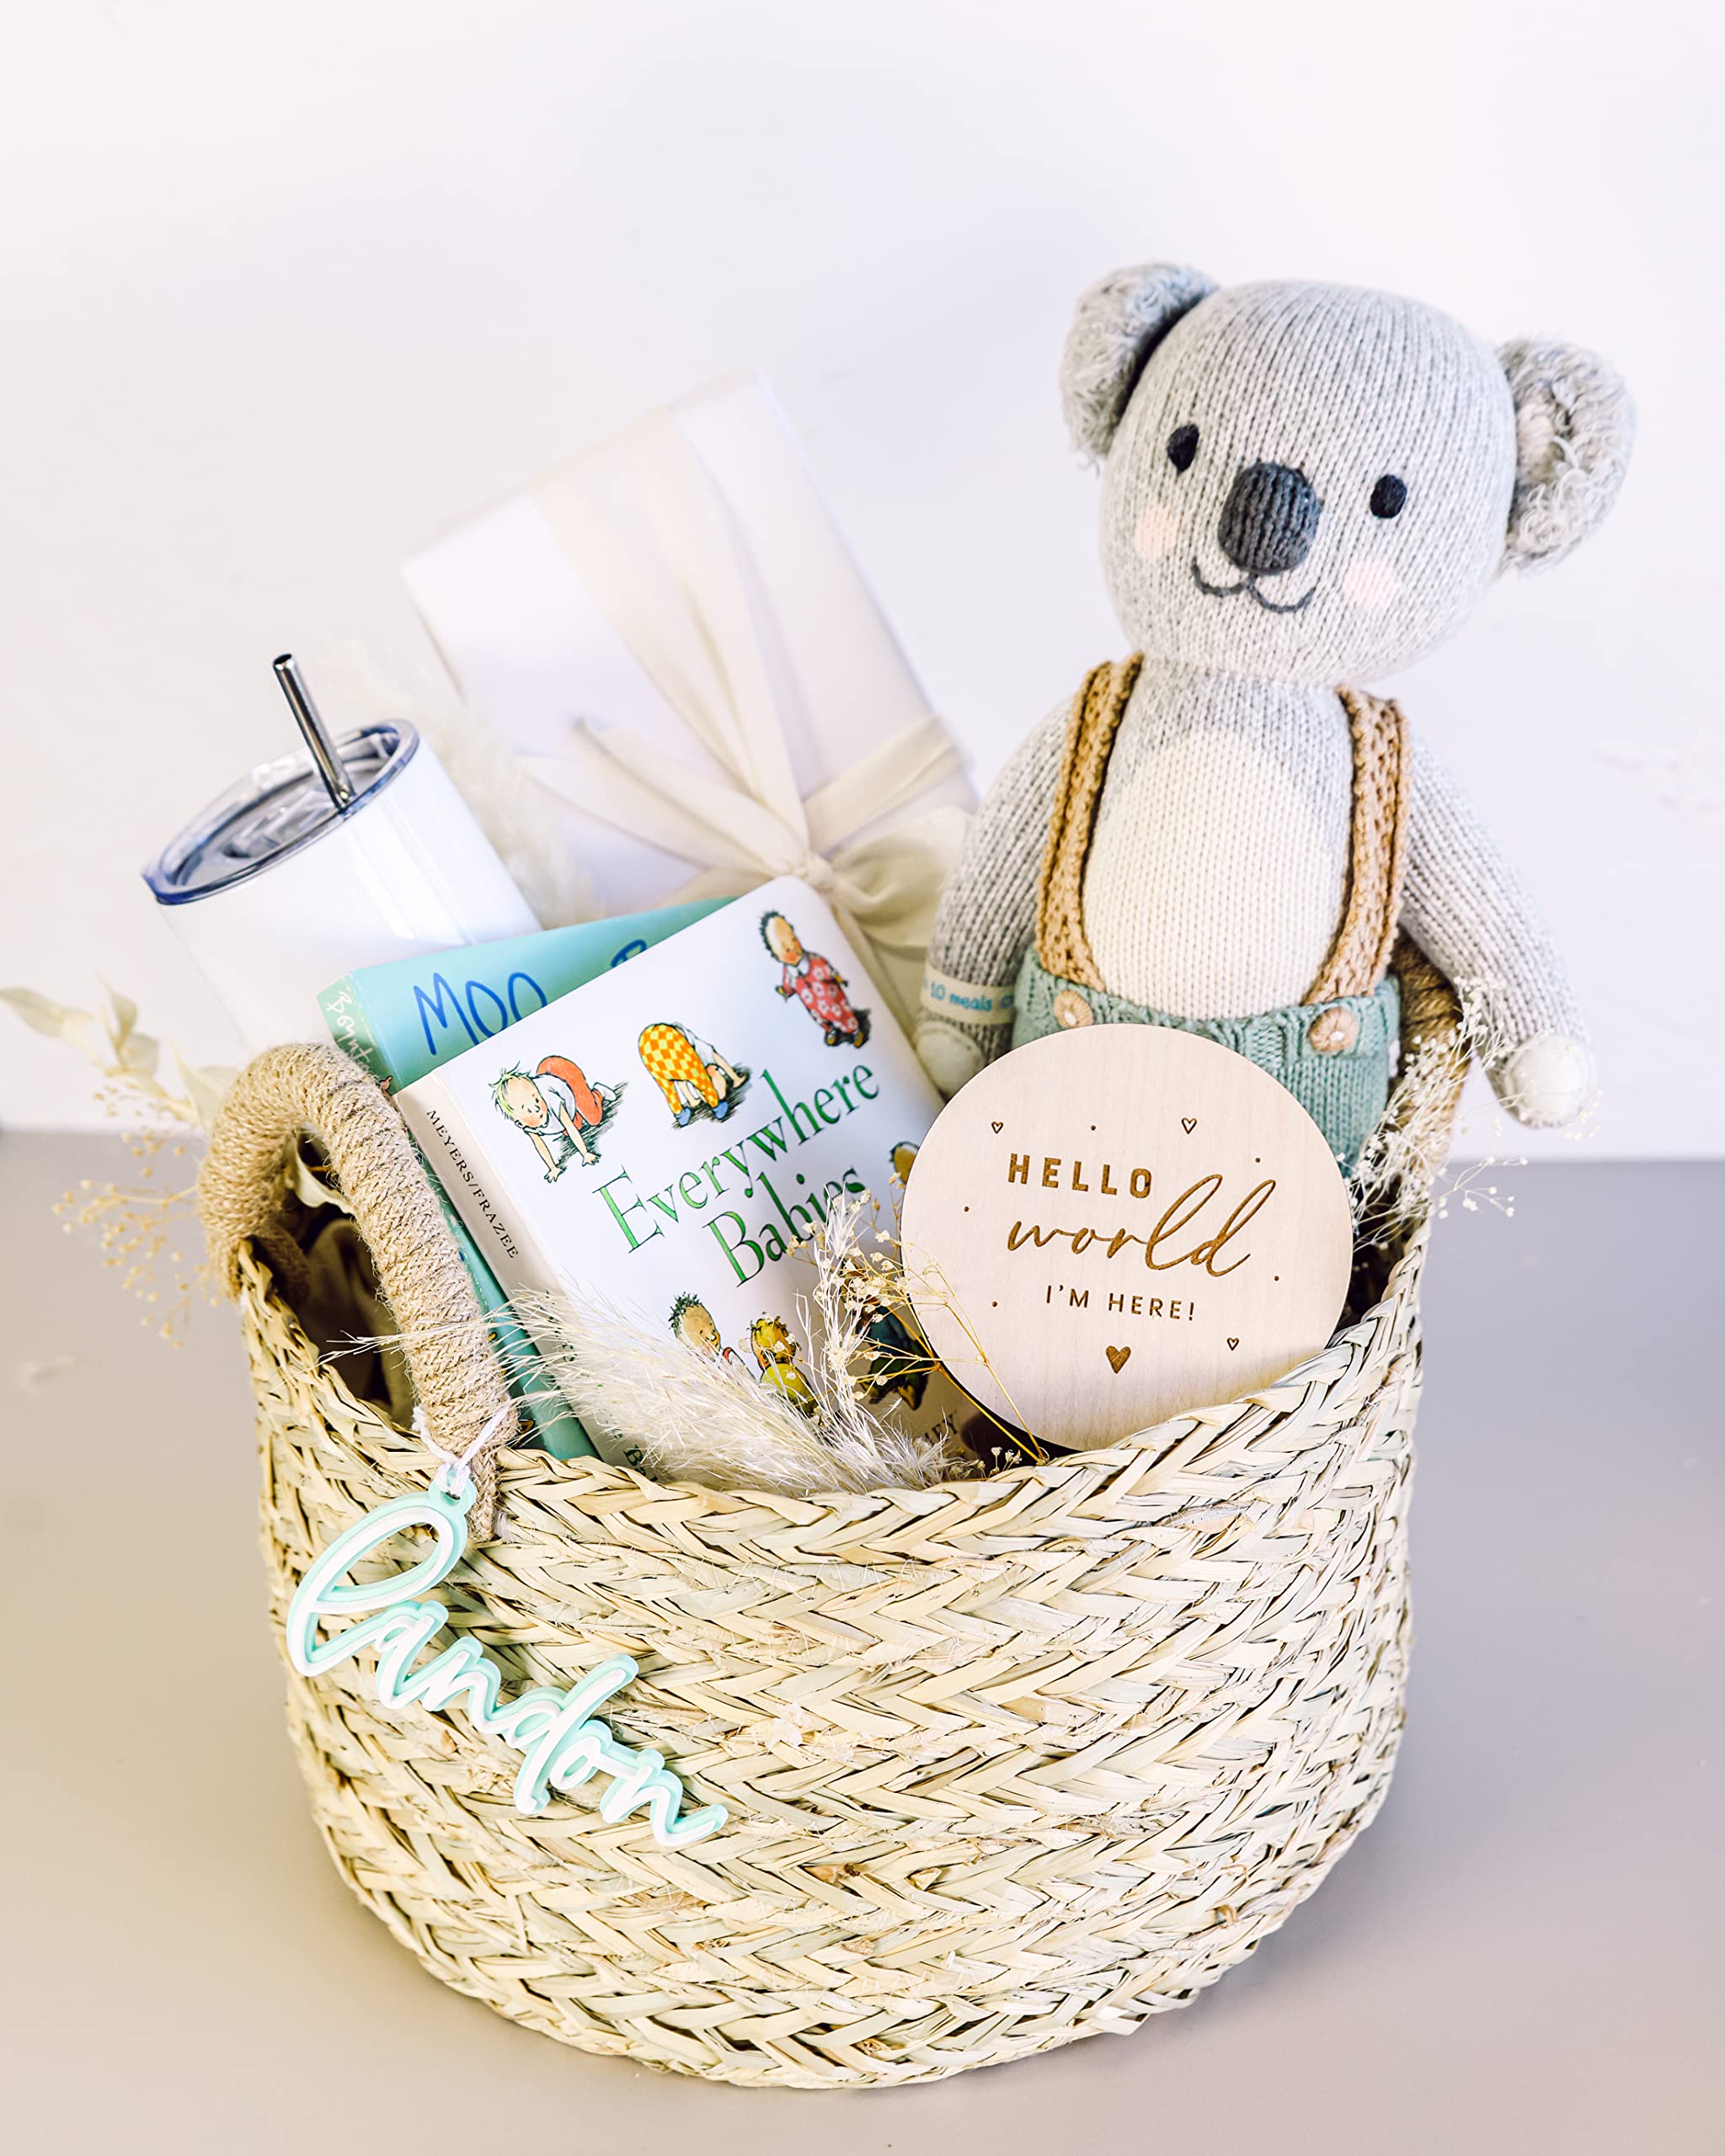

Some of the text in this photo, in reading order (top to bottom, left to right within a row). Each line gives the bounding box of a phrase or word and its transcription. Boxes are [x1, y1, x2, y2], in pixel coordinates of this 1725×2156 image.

[930, 981, 993, 1011] 10 meals
[426, 1109, 519, 1259] MEYERS/FRAZEE
[592, 1064, 880, 1253] Everywhere
[1007, 1153, 1152, 1198] HELLO
[1007, 1173, 1276, 1278] world
[1108, 1292, 1195, 1321] HERE!
[287, 1492, 729, 1847] Landon
